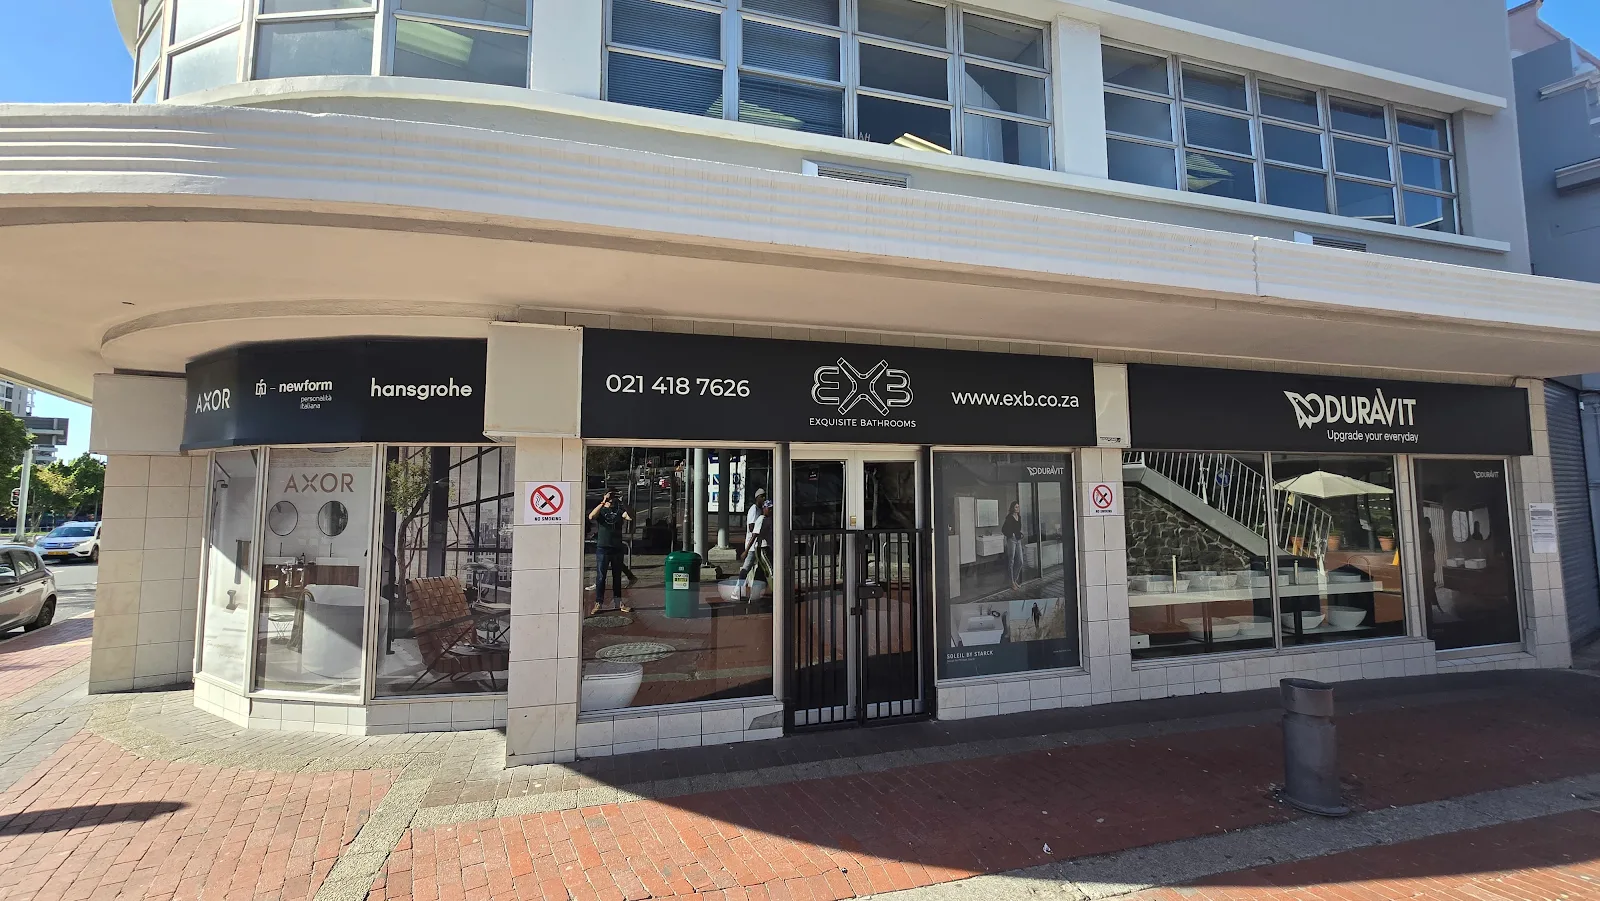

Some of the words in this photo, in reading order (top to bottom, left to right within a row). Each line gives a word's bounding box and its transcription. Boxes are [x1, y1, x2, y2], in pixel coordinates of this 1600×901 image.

[279, 379, 333, 393] newform
[370, 378, 473, 400] hansgrohe
[605, 374, 644, 394] 021
[651, 376, 690, 395] 418
[696, 378, 750, 398] 7626
[195, 388, 231, 413] AXOR
[951, 390, 1080, 408] www.exb.co.za
[1324, 387, 1417, 428] DURAVIT
[809, 417, 857, 427] EXQUISITE
[860, 418, 917, 429] BATHROOMS
[1327, 429, 1364, 443] Upgrade
[1365, 433, 1383, 443] your
[1384, 431, 1419, 444] everyday
[1037, 465, 1064, 475] DURAVIT
[283, 472, 354, 493] AXOR
